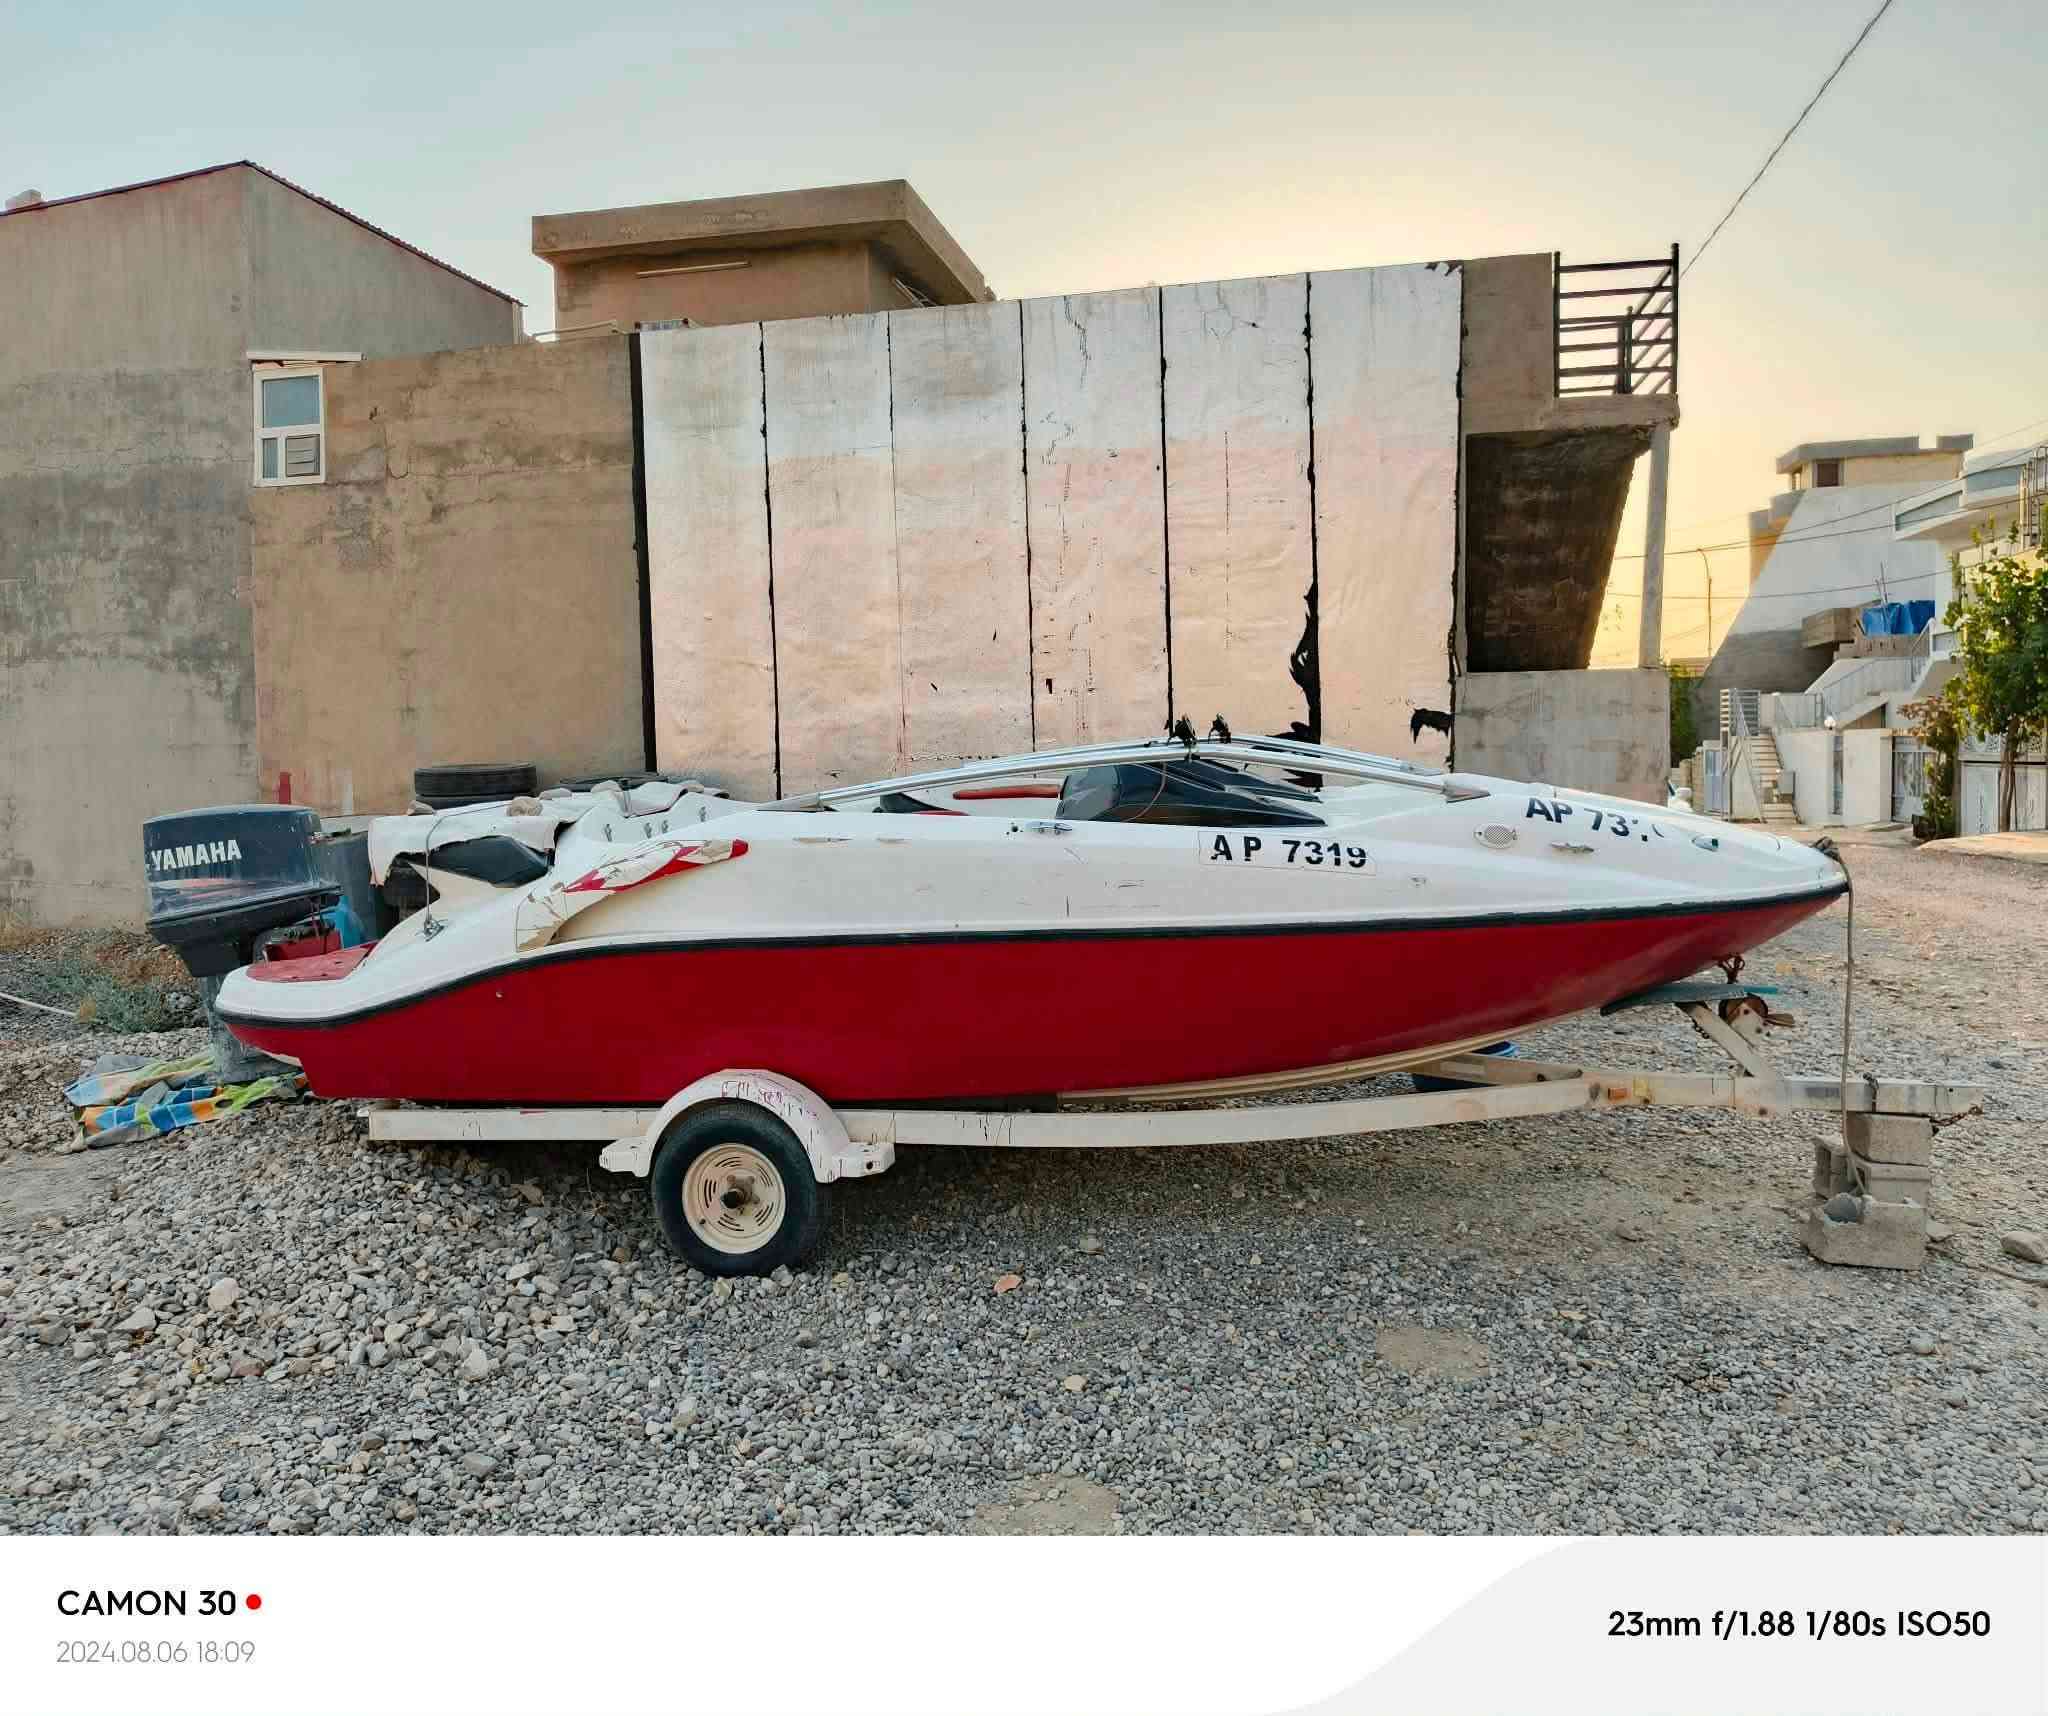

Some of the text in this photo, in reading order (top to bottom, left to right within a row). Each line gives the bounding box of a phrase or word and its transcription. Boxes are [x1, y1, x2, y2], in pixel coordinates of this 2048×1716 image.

[1526, 797, 1665, 842] AP 73
[150, 839, 242, 871] YAMAHA
[1282, 839, 1367, 868] 7319
